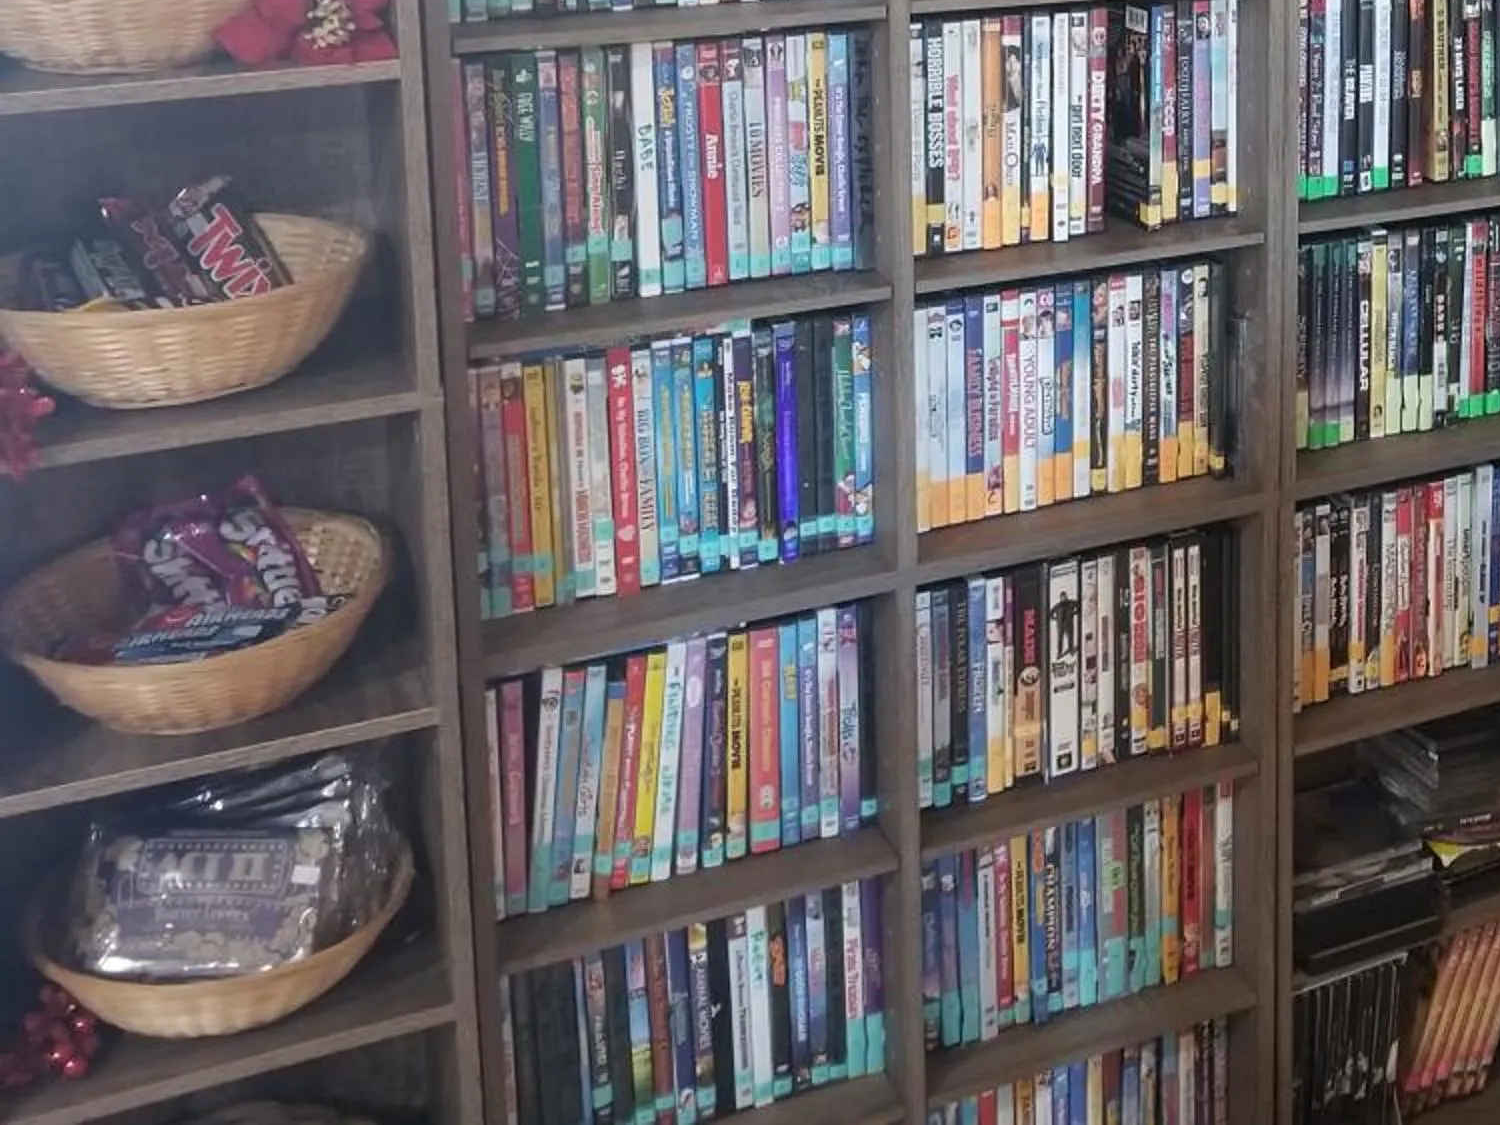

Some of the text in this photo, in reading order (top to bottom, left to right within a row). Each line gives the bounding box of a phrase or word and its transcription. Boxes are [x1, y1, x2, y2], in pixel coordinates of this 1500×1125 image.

[813, 88, 824, 133] PEANUTS
[928, 37, 944, 168] HORRIBLE BOSSES
[1090, 70, 1105, 185] DIRTY GRANDPA
[639, 123, 656, 171] BABE
[705, 133, 721, 180] Annie
[750, 136, 766, 198] MOVIES
[1072, 126, 1084, 150] next
[1072, 153, 1085, 179] door
[1359, 299, 1370, 392] CELLULAR
[967, 396, 983, 456] BUSINESS
[1023, 354, 1037, 449] YOUNG ADULT
